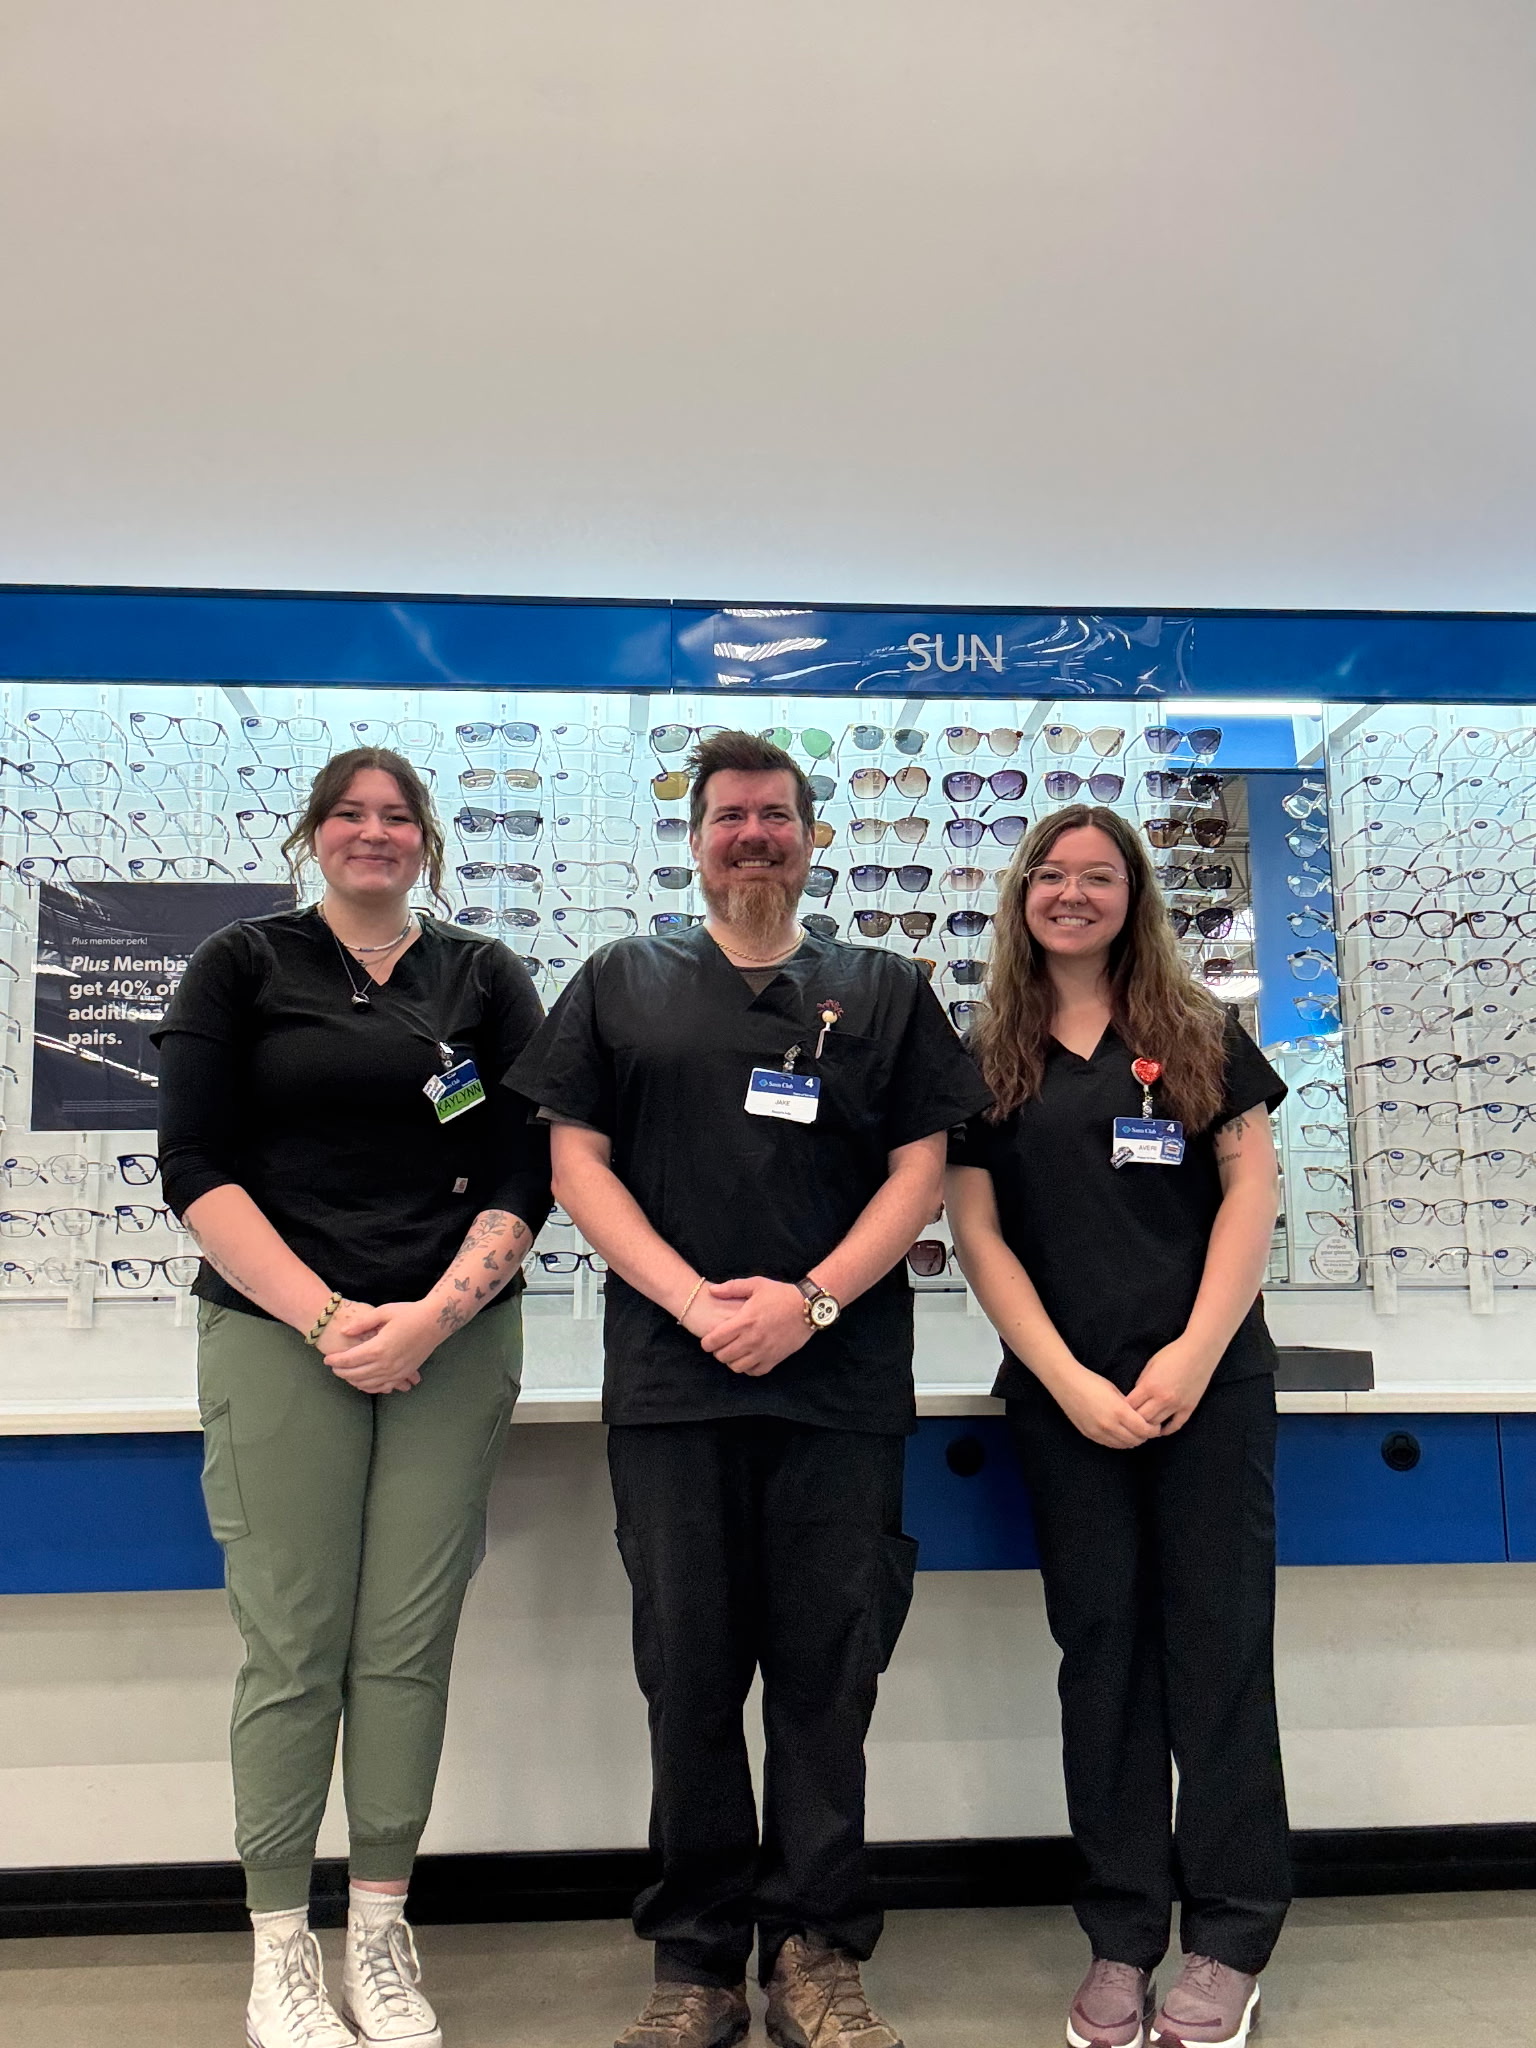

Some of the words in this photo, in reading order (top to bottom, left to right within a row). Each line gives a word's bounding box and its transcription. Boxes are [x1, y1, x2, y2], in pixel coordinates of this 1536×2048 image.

[906, 632, 1003, 673] SUN
[71, 937, 88, 945] Plus
[126, 937, 148, 946] perk!
[70, 955, 110, 972] Plus
[113, 955, 188, 972] Membe
[69, 980, 103, 1000] get
[106, 979, 152, 996] 40%
[156, 979, 181, 996] of
[68, 1028, 123, 1050] pairs.
[805, 1078, 814, 1088] 4
[437, 1081, 482, 1113] KAYLYNN
[1167, 1123, 1176, 1133] 4
